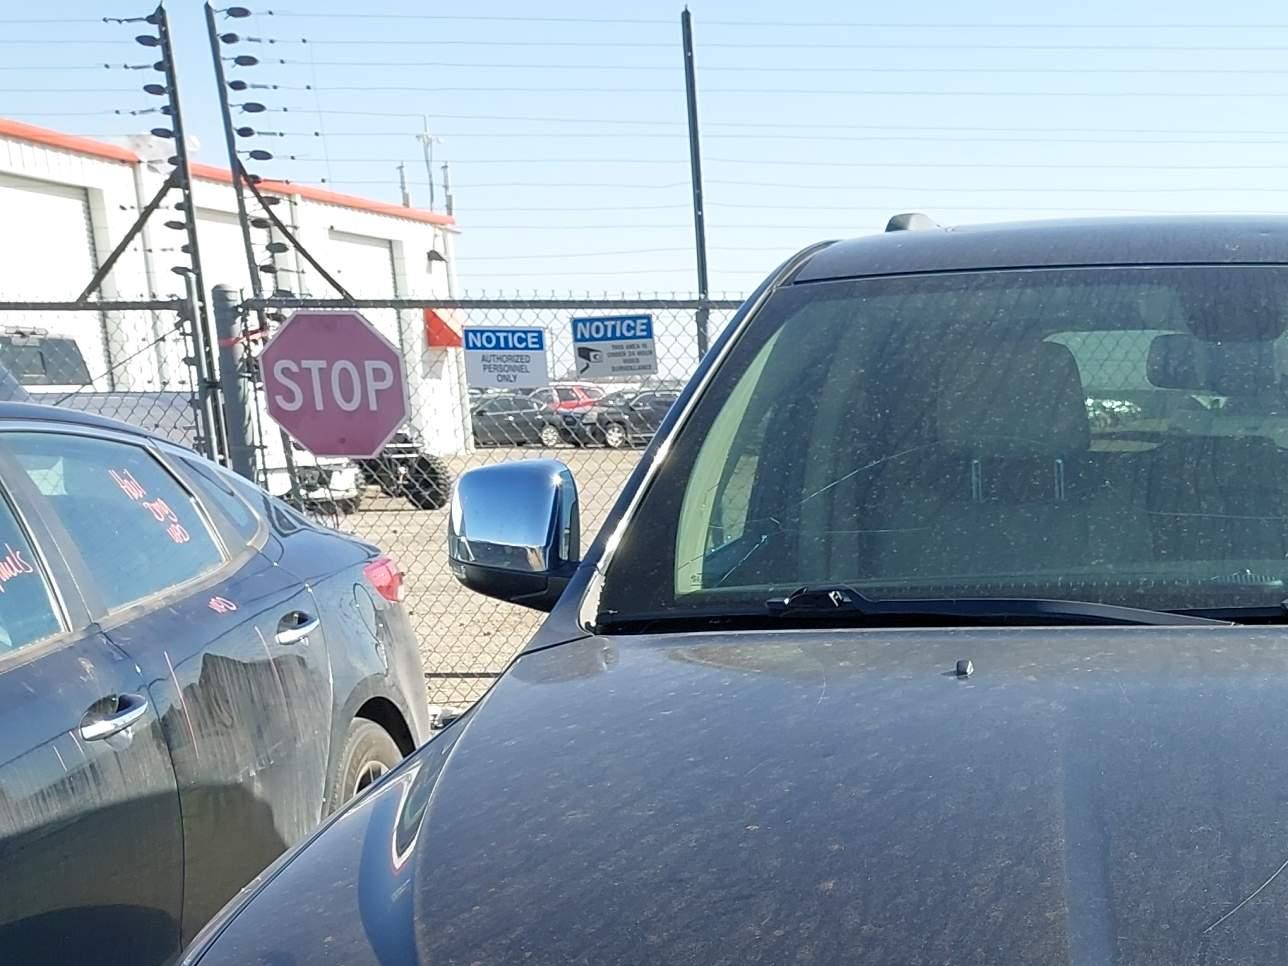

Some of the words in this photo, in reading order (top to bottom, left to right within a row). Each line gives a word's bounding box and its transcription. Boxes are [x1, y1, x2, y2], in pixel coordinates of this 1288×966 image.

[577, 319, 648, 339] NOTICE
[468, 332, 540, 348] NOTICE
[480, 354, 531, 364] AUTHORIZED
[482, 364, 531, 373] PERSONNEL
[273, 359, 394, 411] STOP
[496, 374, 518, 383] ONLY
